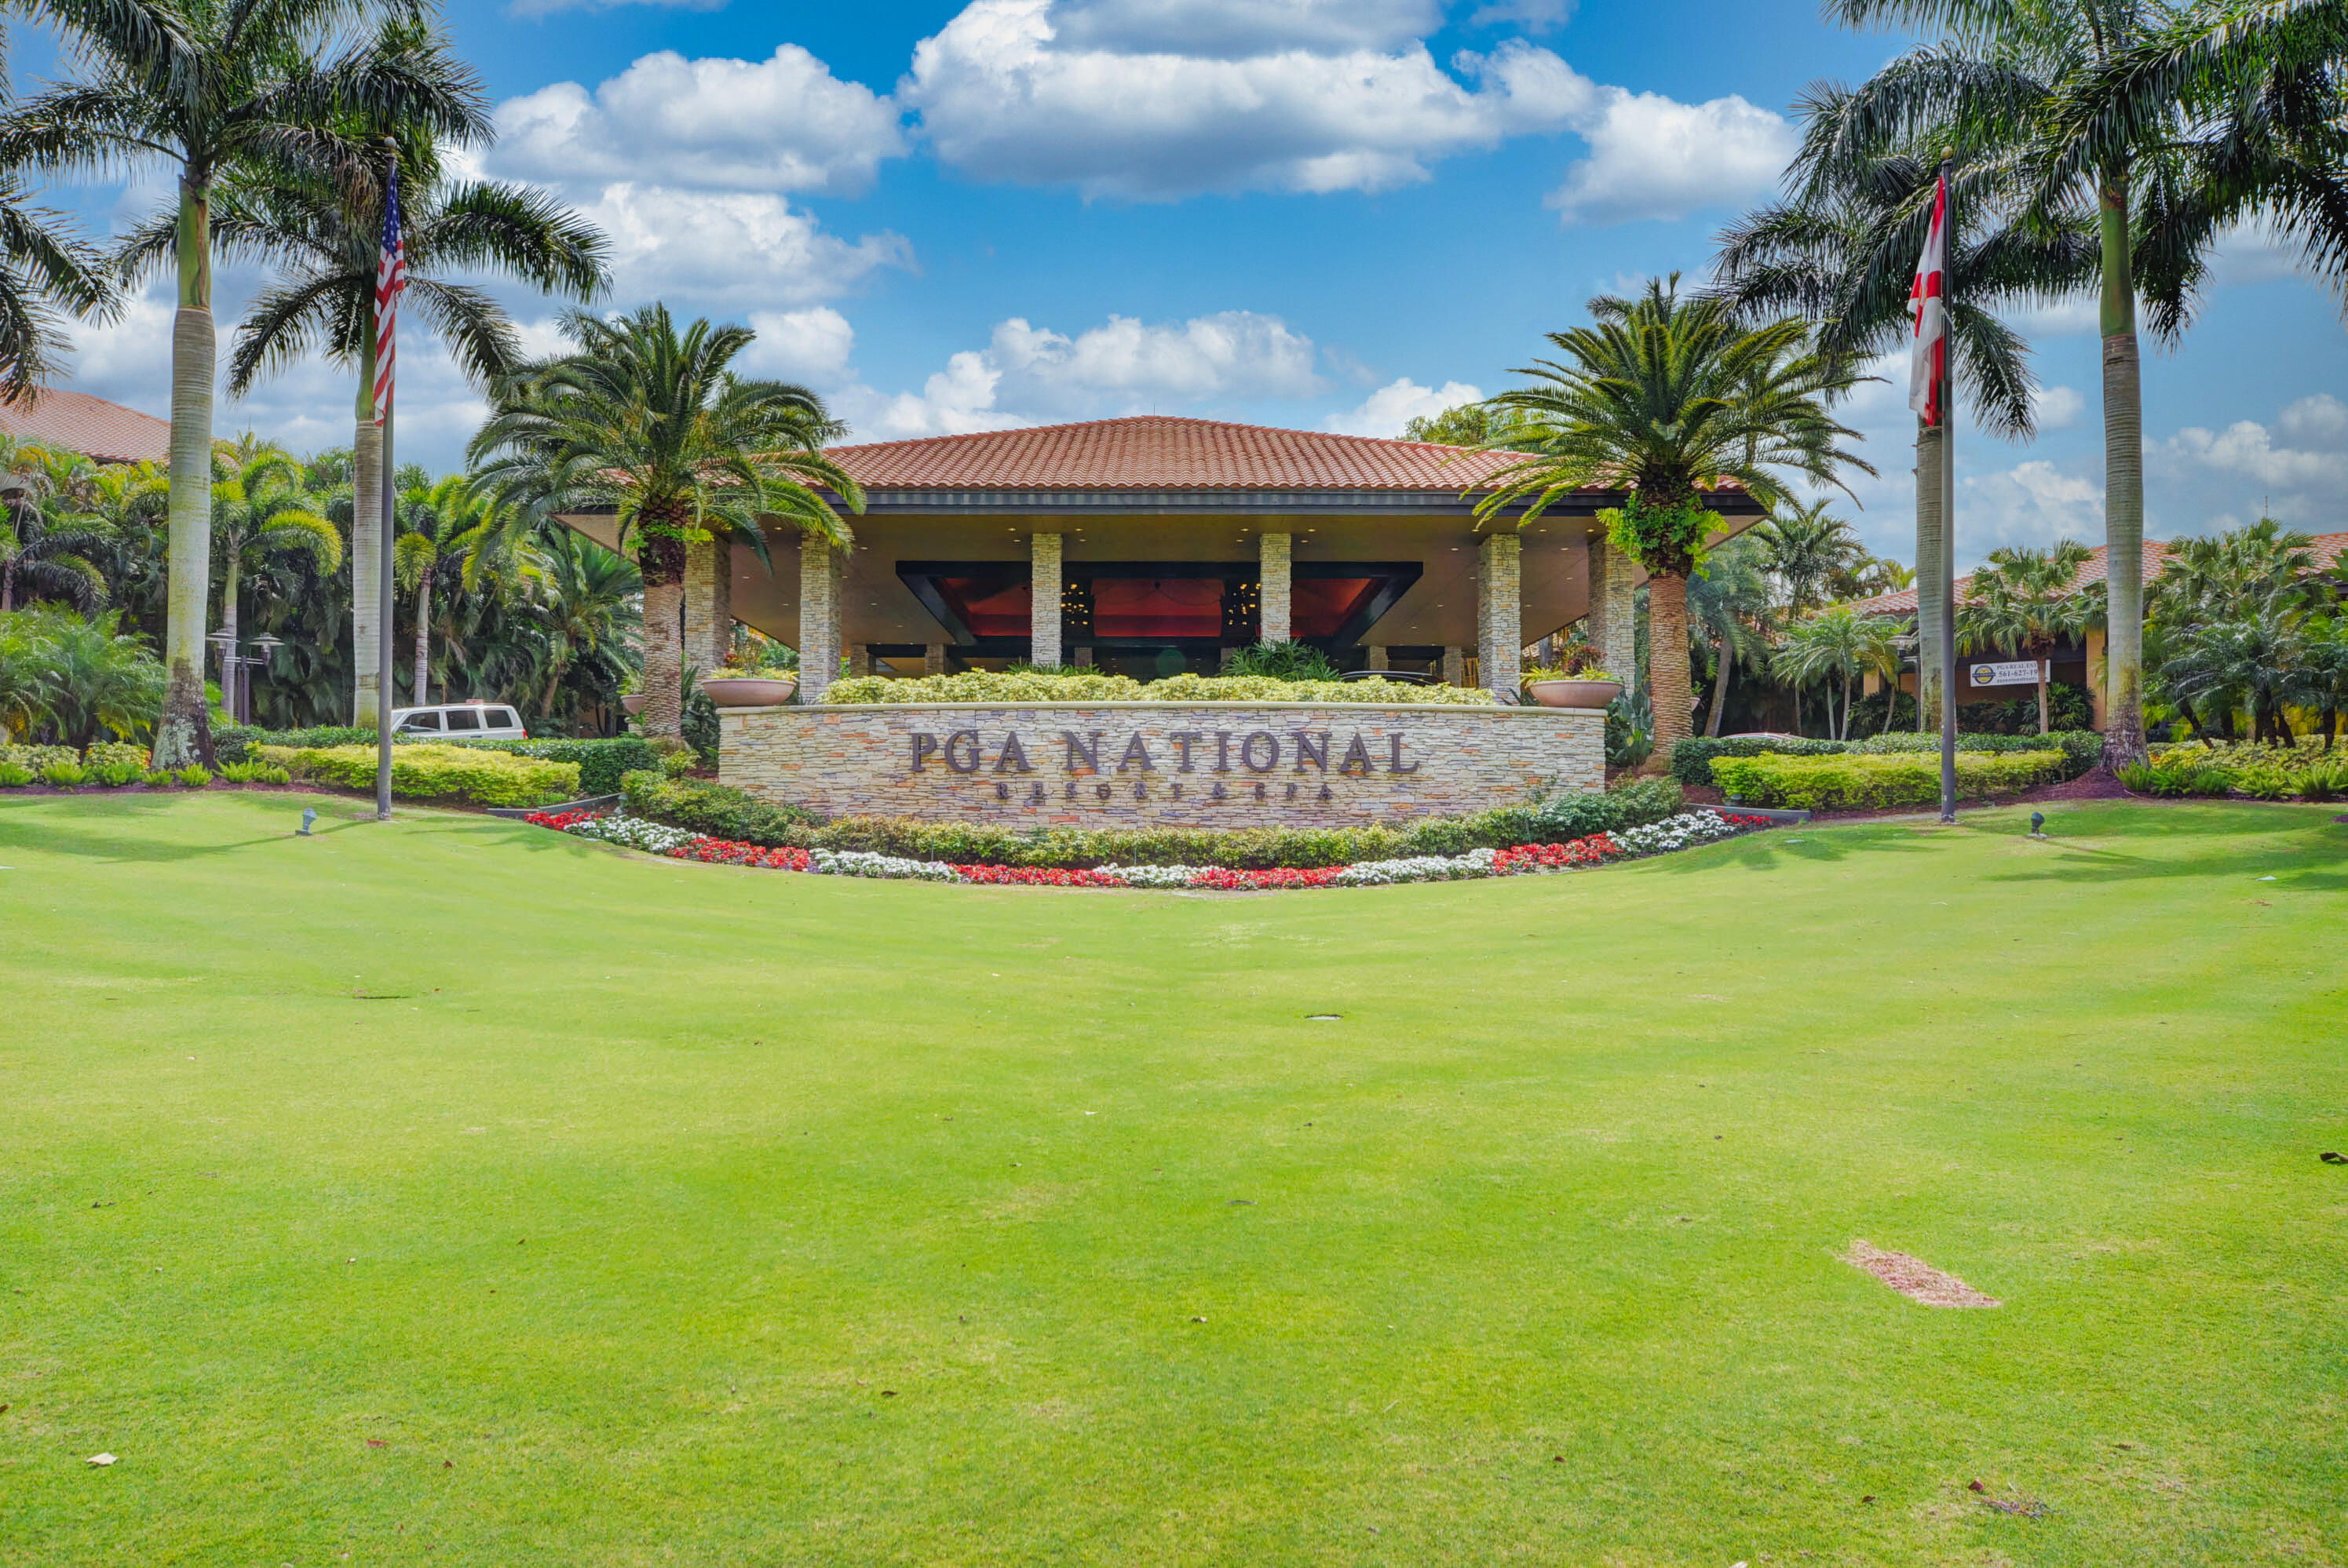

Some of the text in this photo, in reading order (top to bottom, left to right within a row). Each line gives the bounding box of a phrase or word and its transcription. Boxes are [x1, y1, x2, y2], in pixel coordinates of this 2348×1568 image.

[911, 729, 1420, 773] PGA NATIONAL
[995, 781, 1333, 800] RESORT & SPA
